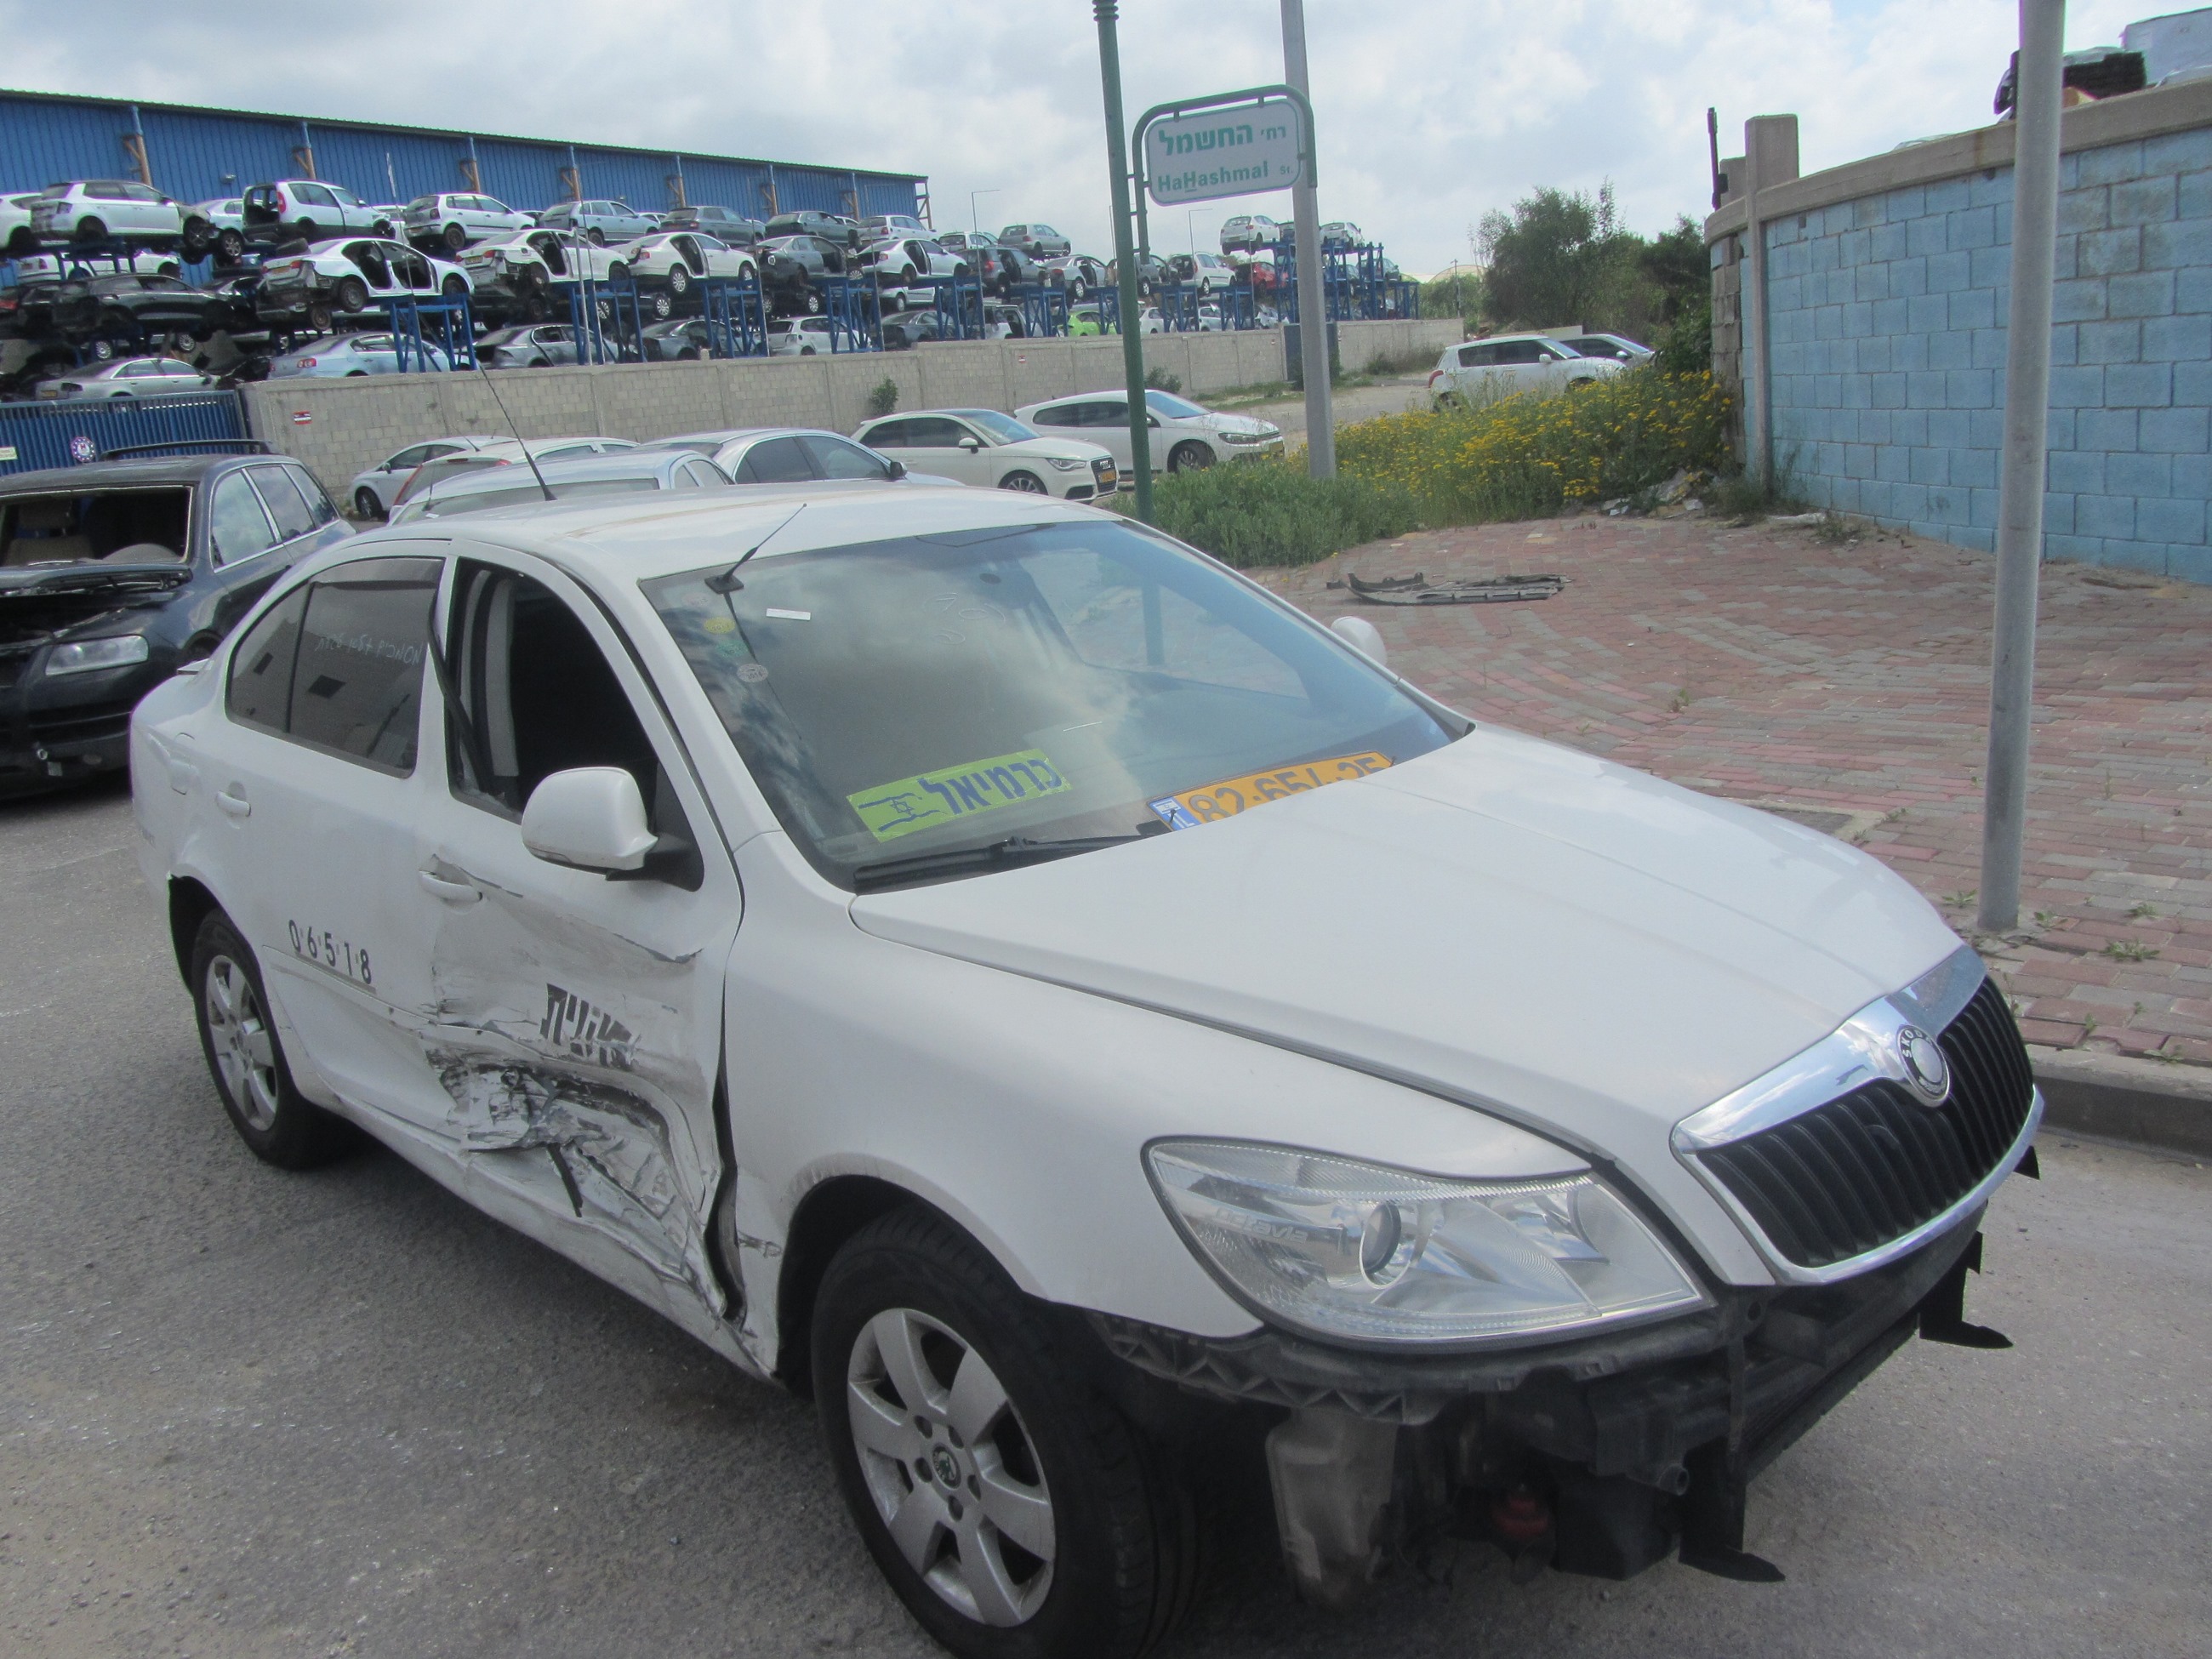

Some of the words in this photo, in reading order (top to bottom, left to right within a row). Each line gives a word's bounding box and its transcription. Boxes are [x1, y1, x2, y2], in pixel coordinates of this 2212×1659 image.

[1158, 124, 1254, 156] החשמל
[1157, 161, 1268, 192] HaHashmal
[1280, 166, 1293, 175] St.
[916, 758, 1063, 815] כרמיאל
